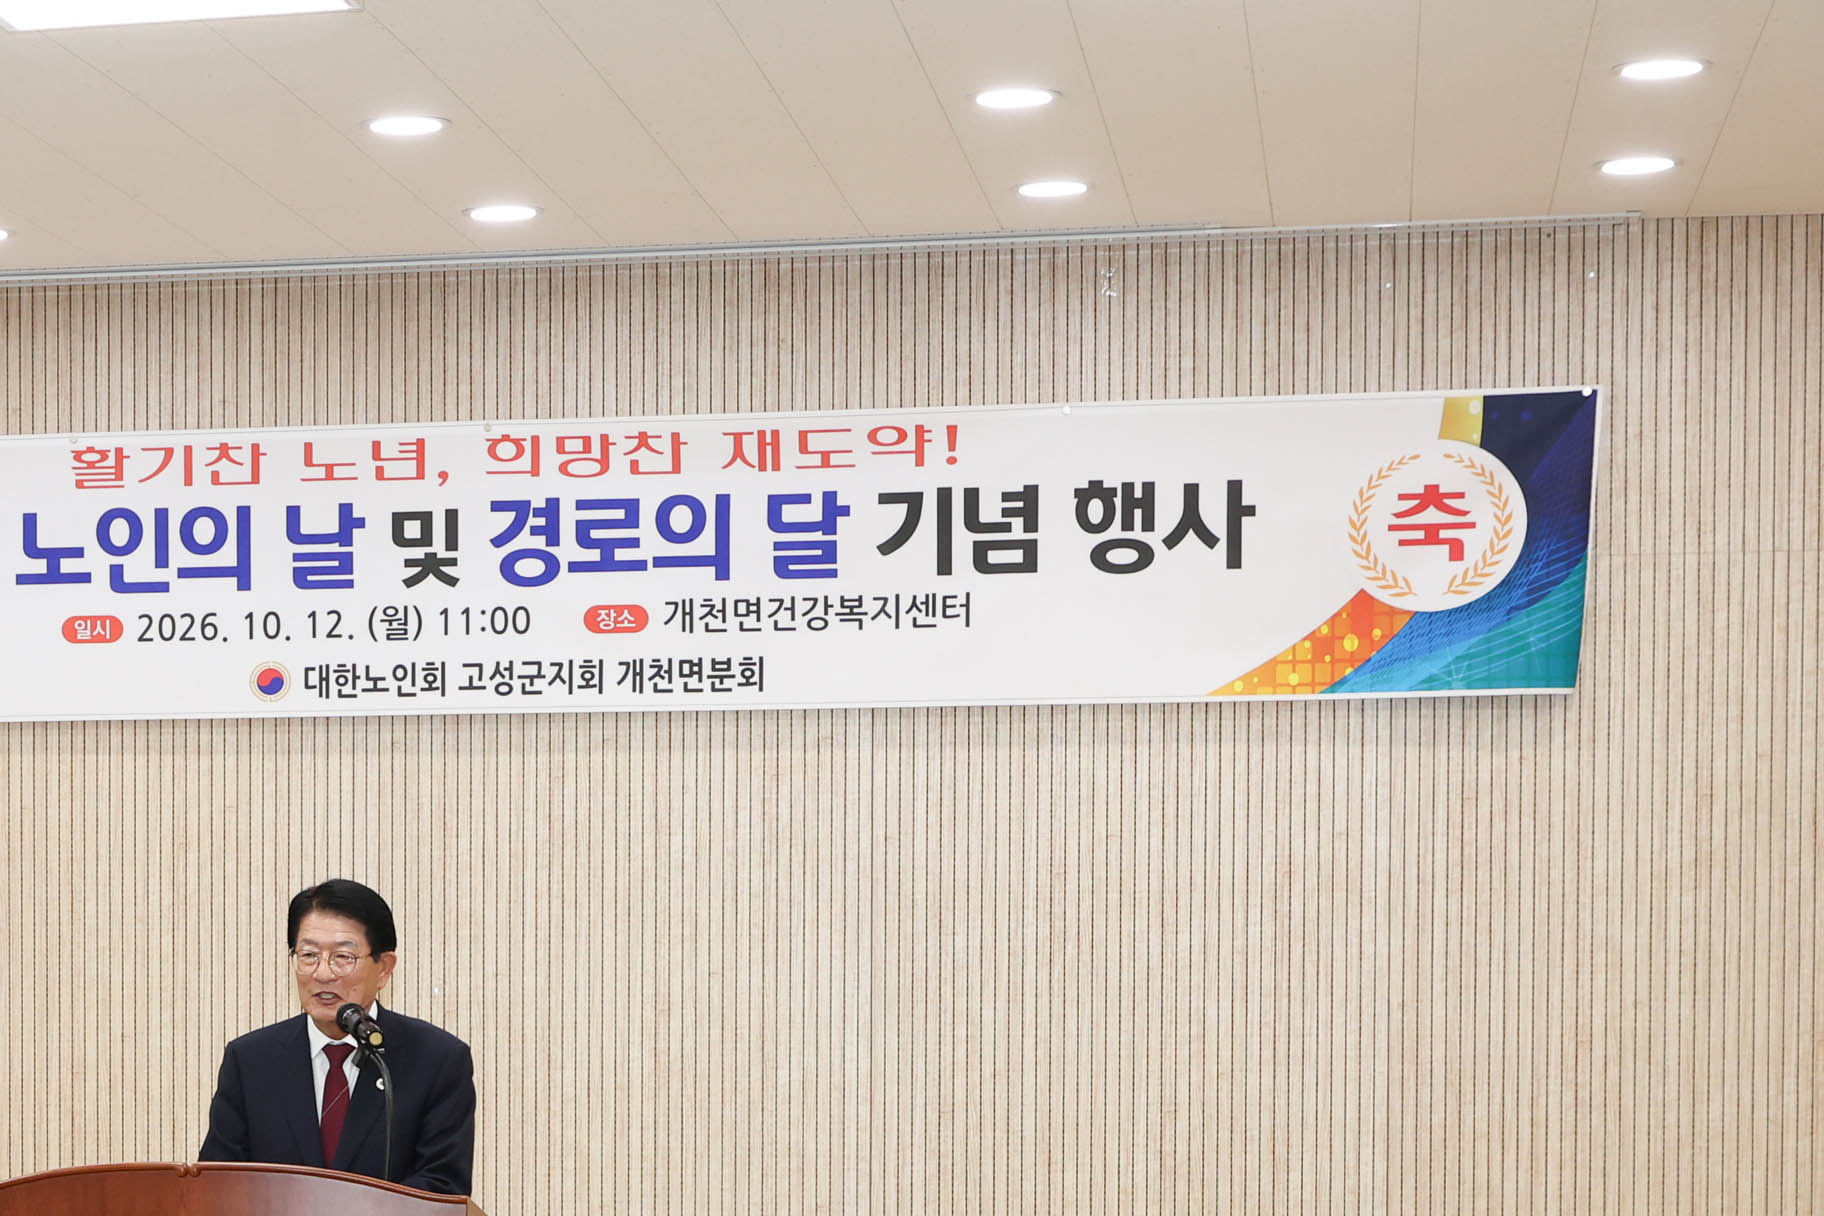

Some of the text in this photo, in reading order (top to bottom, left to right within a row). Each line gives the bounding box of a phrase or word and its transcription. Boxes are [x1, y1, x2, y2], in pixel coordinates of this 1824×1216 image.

[72, 424, 958, 488] 활기찬 노년, 희망찬 재도약!
[16, 505, 251, 593] 노인의
[286, 503, 365, 589] 날
[392, 509, 460, 588] 및
[489, 494, 730, 587] 경로의
[767, 491, 850, 579] 달
[876, 485, 1039, 576] 기념
[1074, 480, 1256, 574] 행사
[1386, 484, 1478, 562] 축
[74, 592, 970, 642] 일시 2026. 10. 12. (월) 11:00 장소 개천면건강복지센터
[304, 656, 763, 699] 대한노인회 고성군지회 개천면분회
